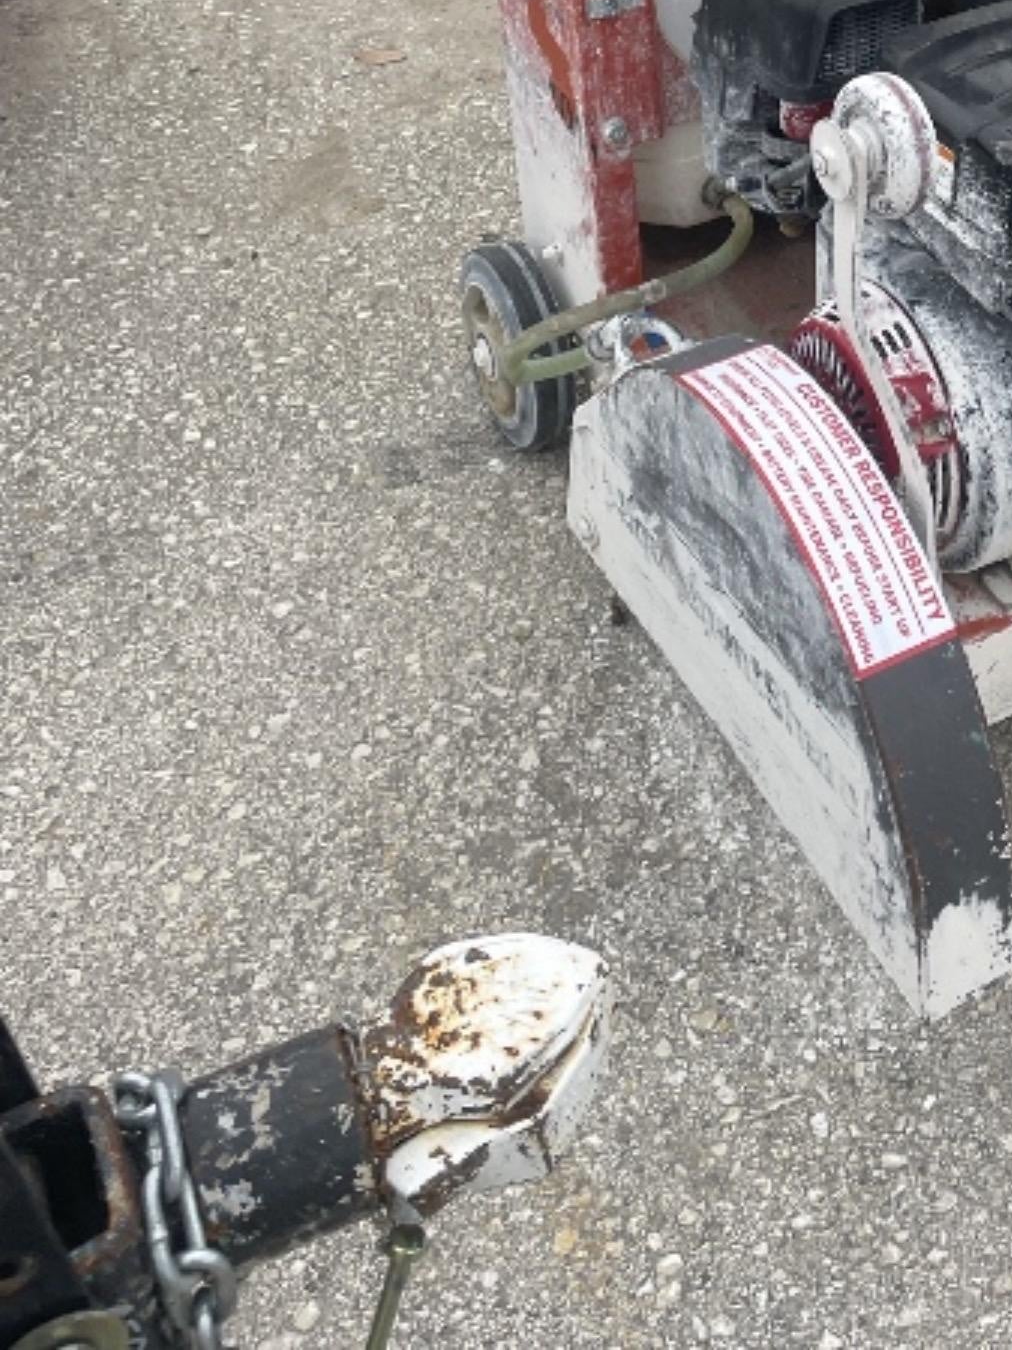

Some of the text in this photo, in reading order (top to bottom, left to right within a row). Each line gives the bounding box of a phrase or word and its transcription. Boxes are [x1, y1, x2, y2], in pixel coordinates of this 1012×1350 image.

[796, 382, 945, 621] CUSTOMER RESPONSIBILITY
[875, 572, 904, 616] START
